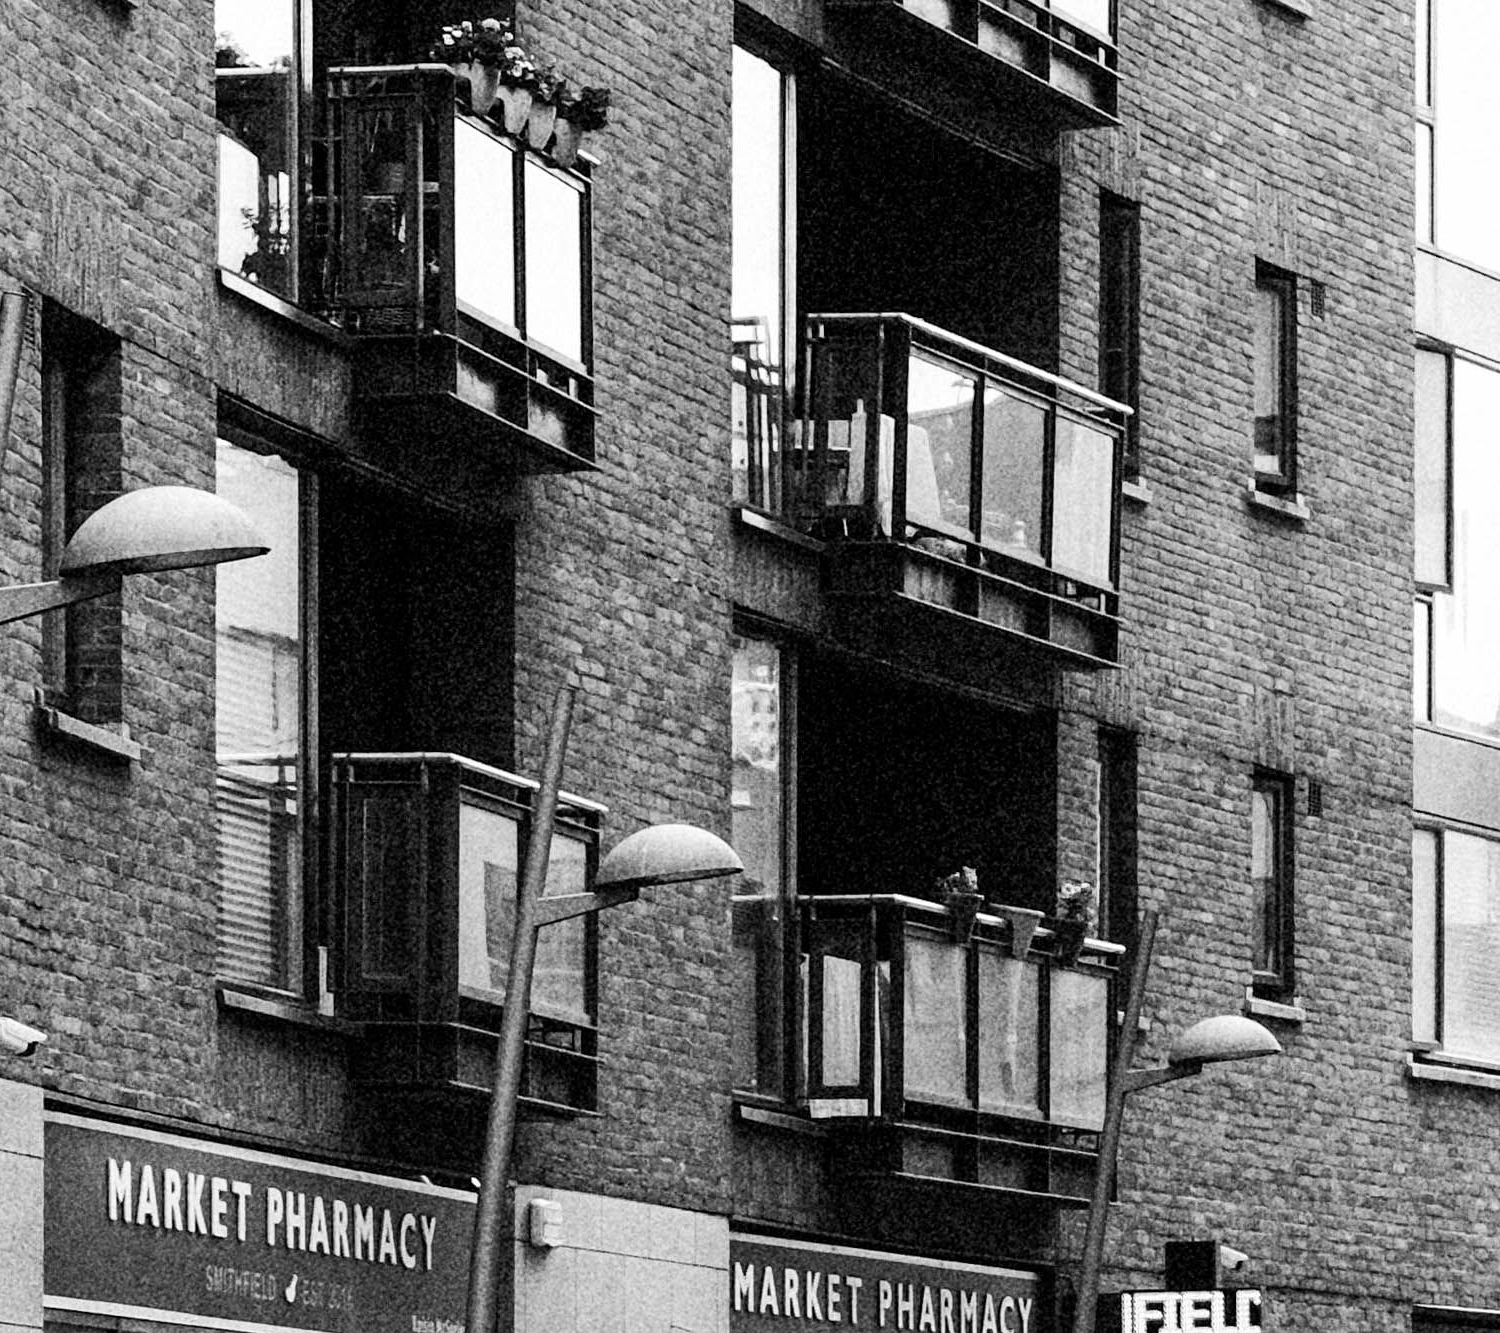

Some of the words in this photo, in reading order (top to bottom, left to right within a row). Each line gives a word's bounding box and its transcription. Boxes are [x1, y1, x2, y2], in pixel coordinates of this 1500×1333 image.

[108, 1157, 251, 1241] MARKET
[267, 1187, 436, 1270] PHARMACY
[205, 1264, 276, 1301] SMITHFIELD
[734, 1261, 862, 1324] MARKET
